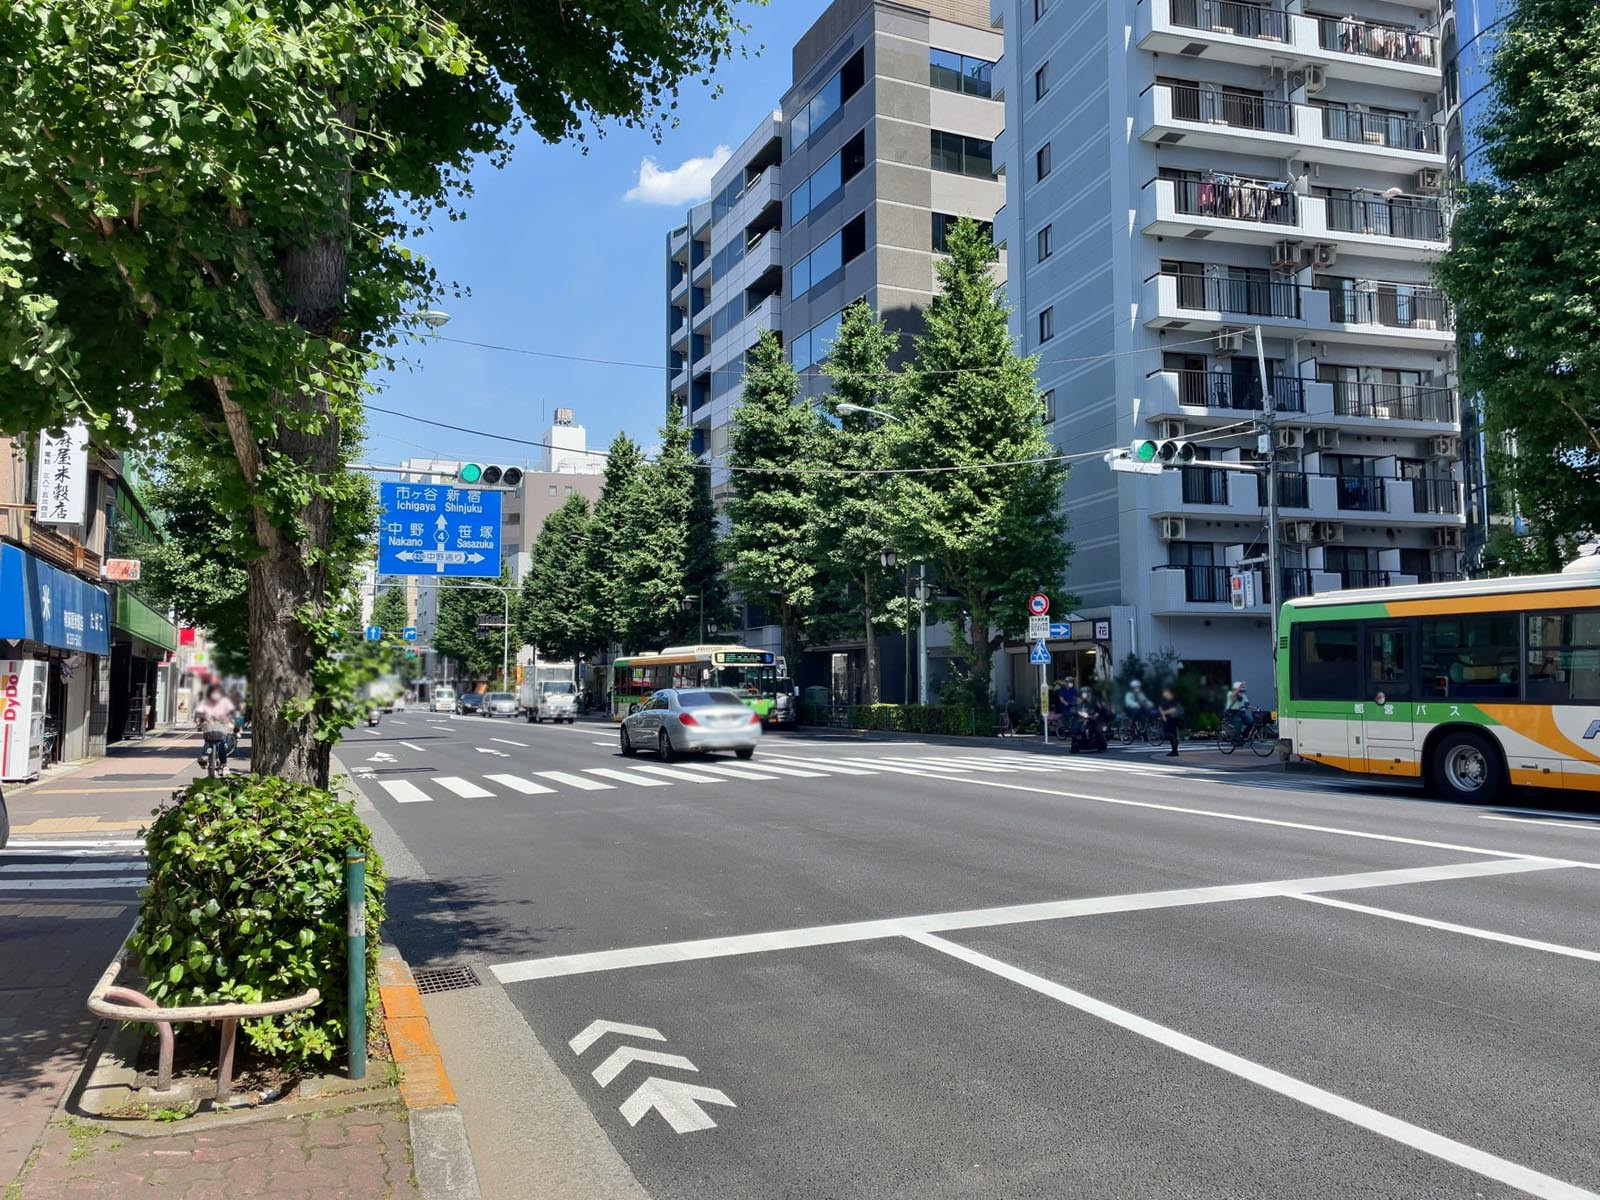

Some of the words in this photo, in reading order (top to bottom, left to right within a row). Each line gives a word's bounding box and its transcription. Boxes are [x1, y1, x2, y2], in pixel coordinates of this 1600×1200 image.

[446, 488, 482, 503] 新宿
[397, 500, 437, 512] Ichigaya
[445, 502, 483, 514] Shinjuku
[388, 522, 424, 537] 中野
[458, 524, 494, 539] 笹塚
[437, 532, 445, 541] 4
[388, 536, 423, 547] Nakano
[457, 538, 494, 549] Sasazuka
[426, 552, 462, 562] 中野通り
[42, 584, 51, 622] 米
[4, 674, 20, 721] DyDo
[1354, 703, 1460, 717] 都営バス
